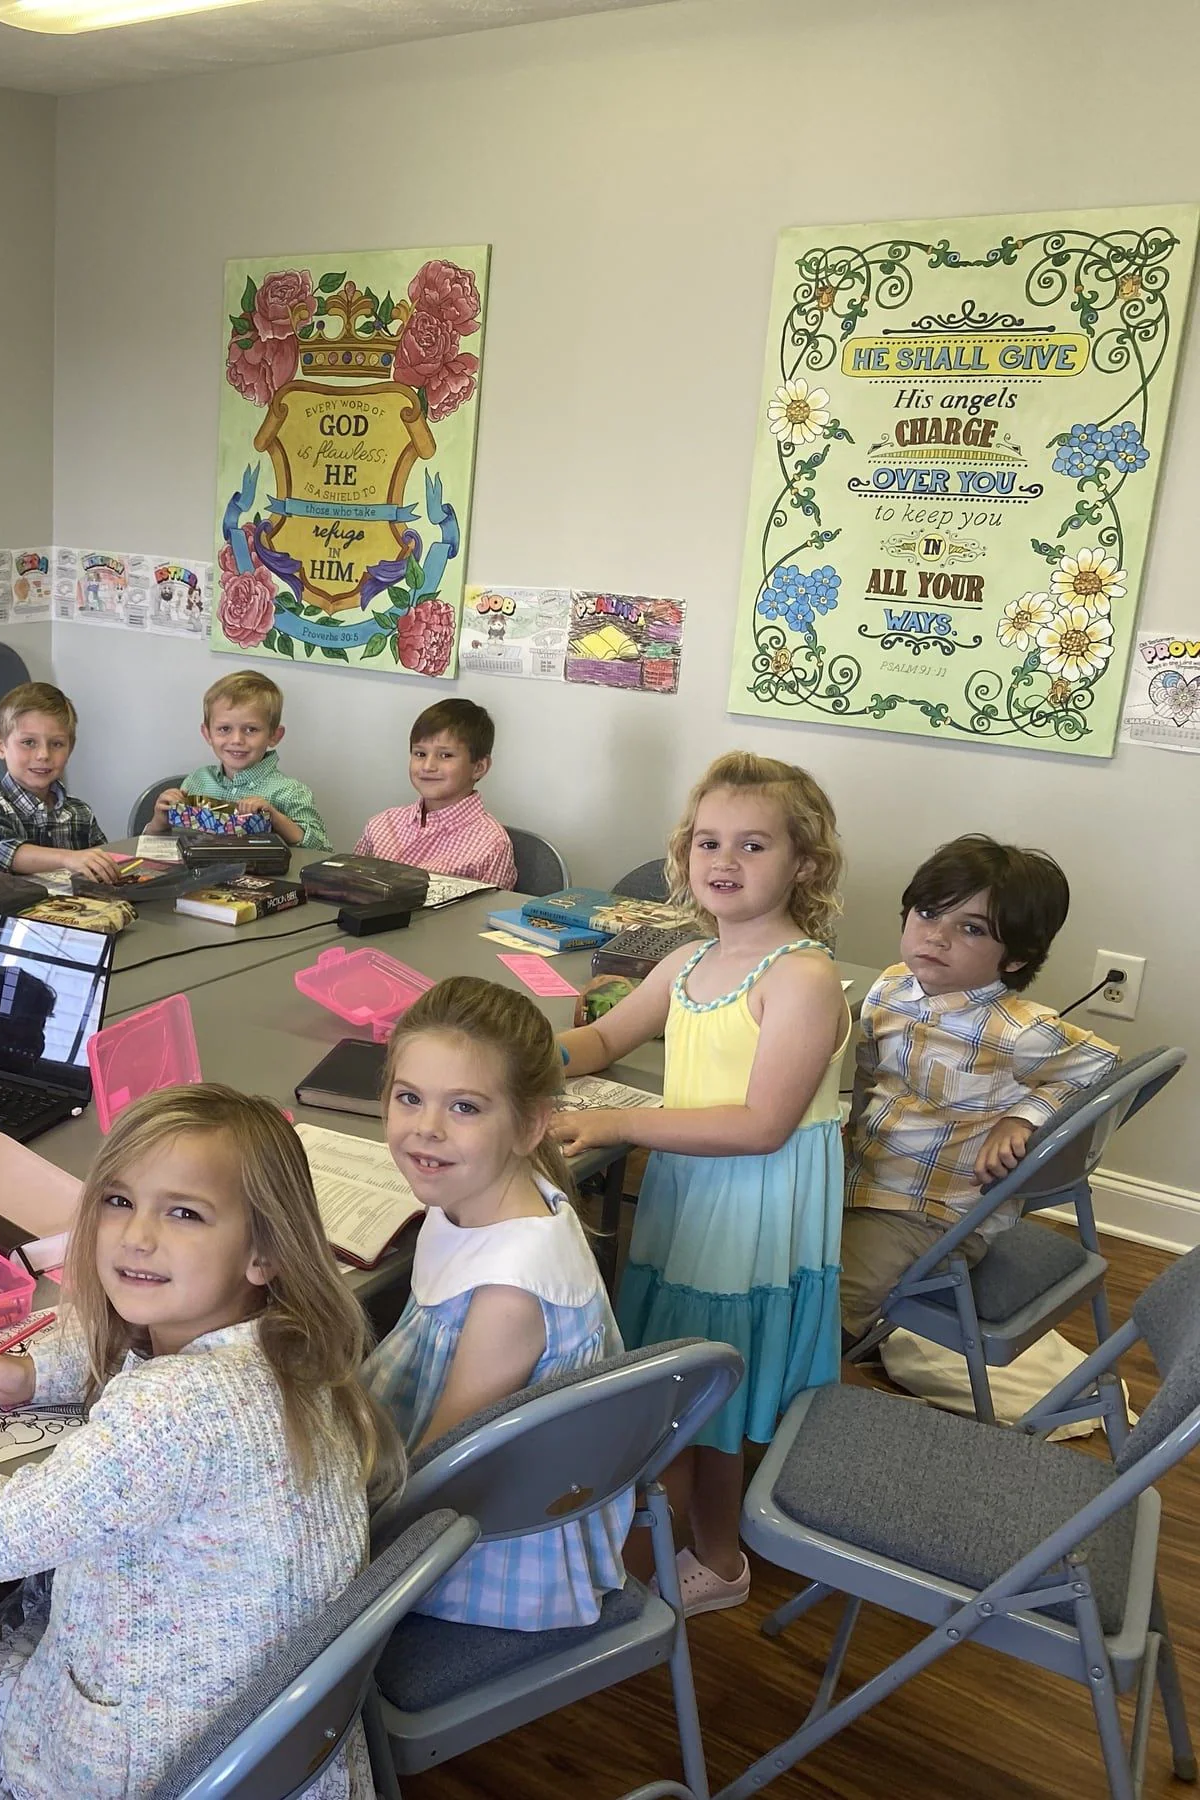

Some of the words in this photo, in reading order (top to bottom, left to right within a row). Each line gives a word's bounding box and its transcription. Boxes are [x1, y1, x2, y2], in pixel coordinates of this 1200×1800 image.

[851, 345, 888, 371] HE
[895, 345, 990, 371] SHALL
[997, 344, 1078, 371] GIVE
[305, 400, 337, 418] EVERY
[340, 400, 370, 413] WORD
[371, 406, 386, 418] OF
[893, 388, 936, 409] His
[939, 387, 1018, 414] angels
[319, 414, 369, 437] GOD
[894, 417, 999, 449] CHARGE
[297, 445, 312, 460] is
[312, 440, 389, 468] flawless;
[323, 464, 357, 486] HE
[872, 467, 950, 493] OVER
[956, 469, 1017, 495] YOU
[303, 482, 315, 494] IS
[314, 489, 321, 498] A
[322, 491, 361, 502] SHIELD
[362, 485, 377, 498] TO
[305, 504, 330, 516] those
[354, 508, 376, 517] take
[873, 502, 896, 522] to
[900, 502, 954, 527] keep
[960, 511, 1004, 528] you
[312, 520, 365, 550] refuge
[328, 547, 341, 559] IN
[923, 539, 943, 555] IN
[309, 560, 359, 583] HIM.
[865, 568, 909, 596] ALL
[917, 571, 985, 602] YOUR
[476, 595, 516, 616] JOB
[575, 595, 642, 624] PSALMS
[302, 626, 339, 641] Proverbs
[340, 632, 359, 642] 30:5
[884, 609, 959, 637] WAYS.
[880, 661, 918, 674] PSALM
